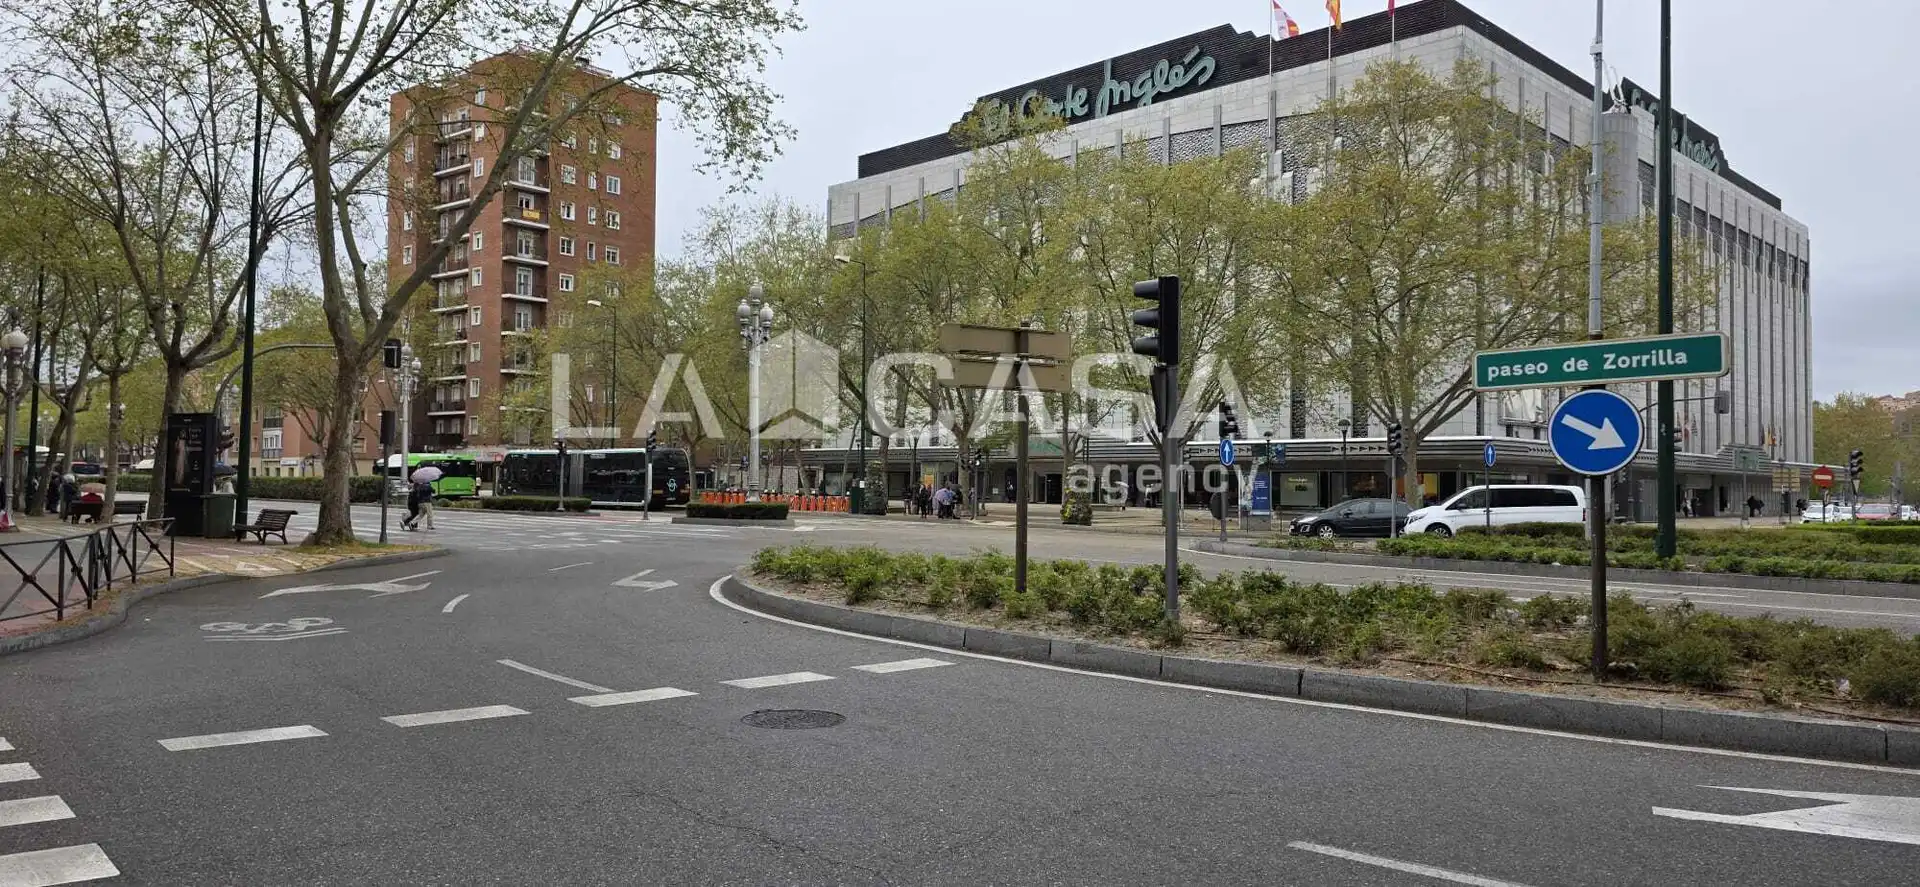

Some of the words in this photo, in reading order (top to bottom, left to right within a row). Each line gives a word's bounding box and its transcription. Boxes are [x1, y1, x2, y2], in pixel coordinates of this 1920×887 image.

[1095, 45, 1216, 120] Inglés
[1488, 361, 1549, 381] paseo
[1562, 357, 1588, 373] de
[1603, 348, 1688, 370] Zorrilla
